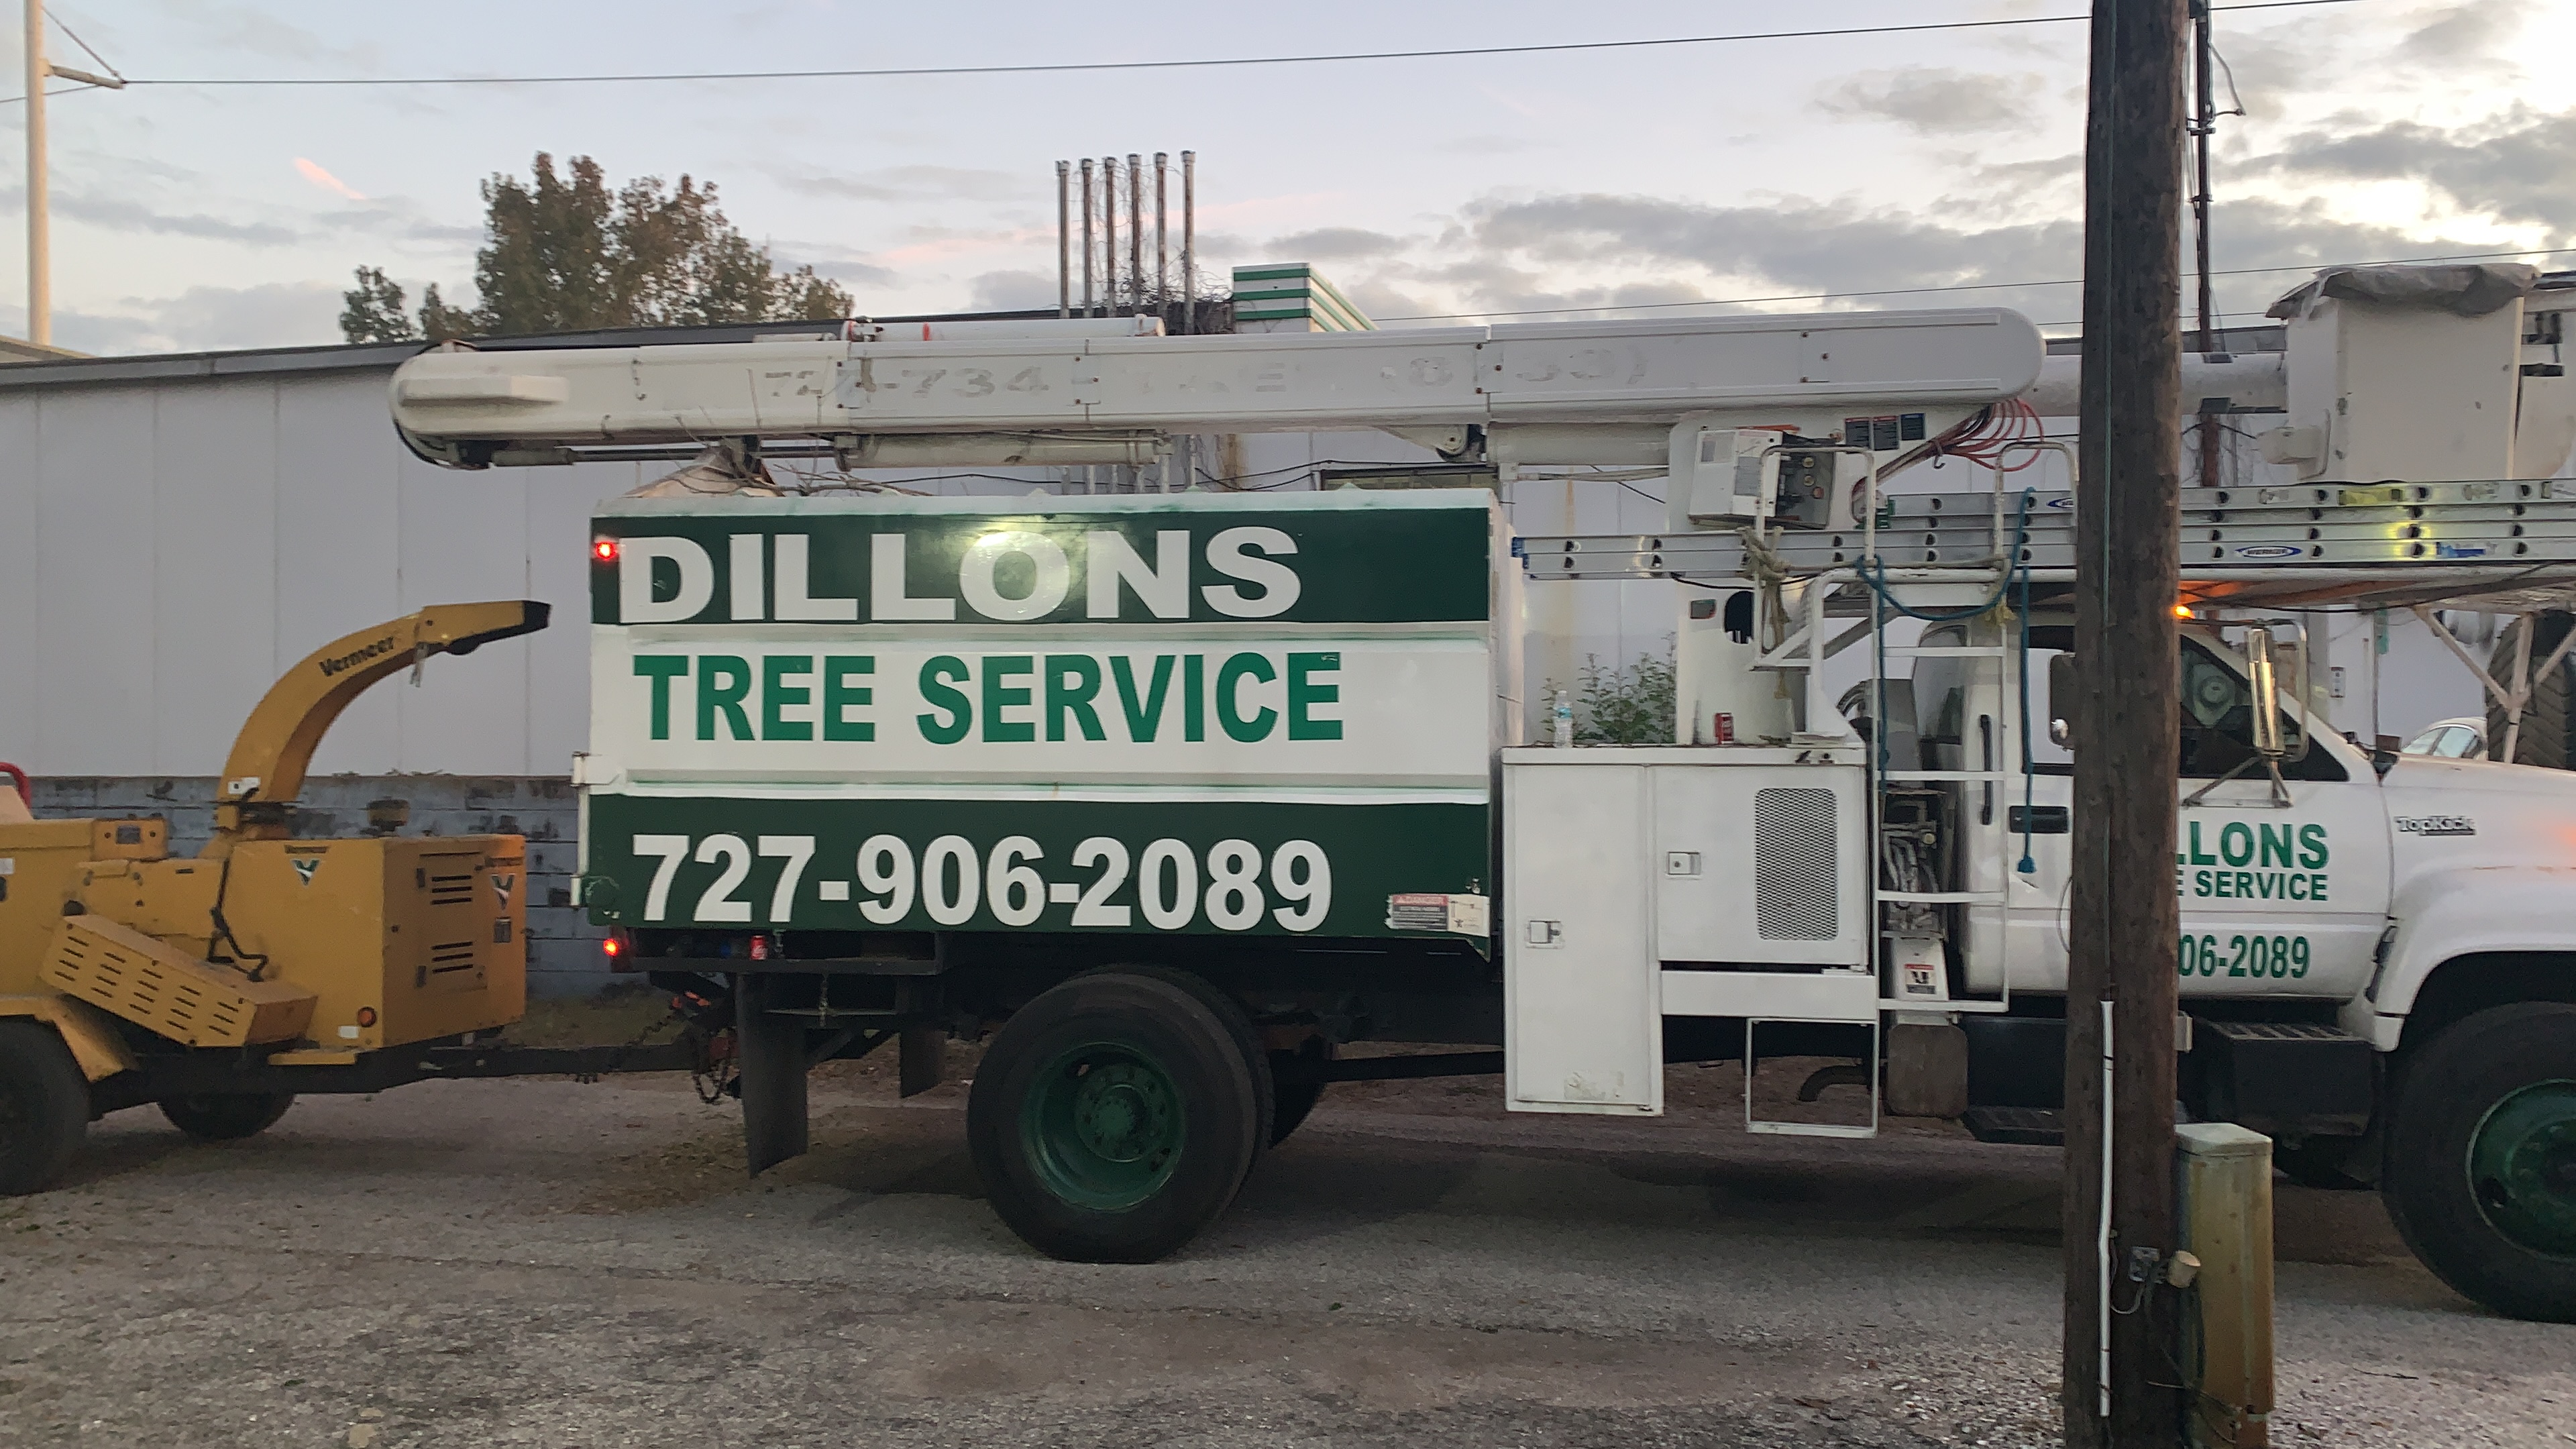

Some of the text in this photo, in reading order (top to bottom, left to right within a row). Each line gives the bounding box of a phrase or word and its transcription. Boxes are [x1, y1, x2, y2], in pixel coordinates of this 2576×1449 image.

[619, 526, 1301, 624] DILLONS
[319, 636, 394, 677] Vermeer
[633, 652, 1343, 745] TREE SERVICE
[633, 833, 1332, 932] 727-906-2089
[2195, 870, 2329, 901] SERVICE
